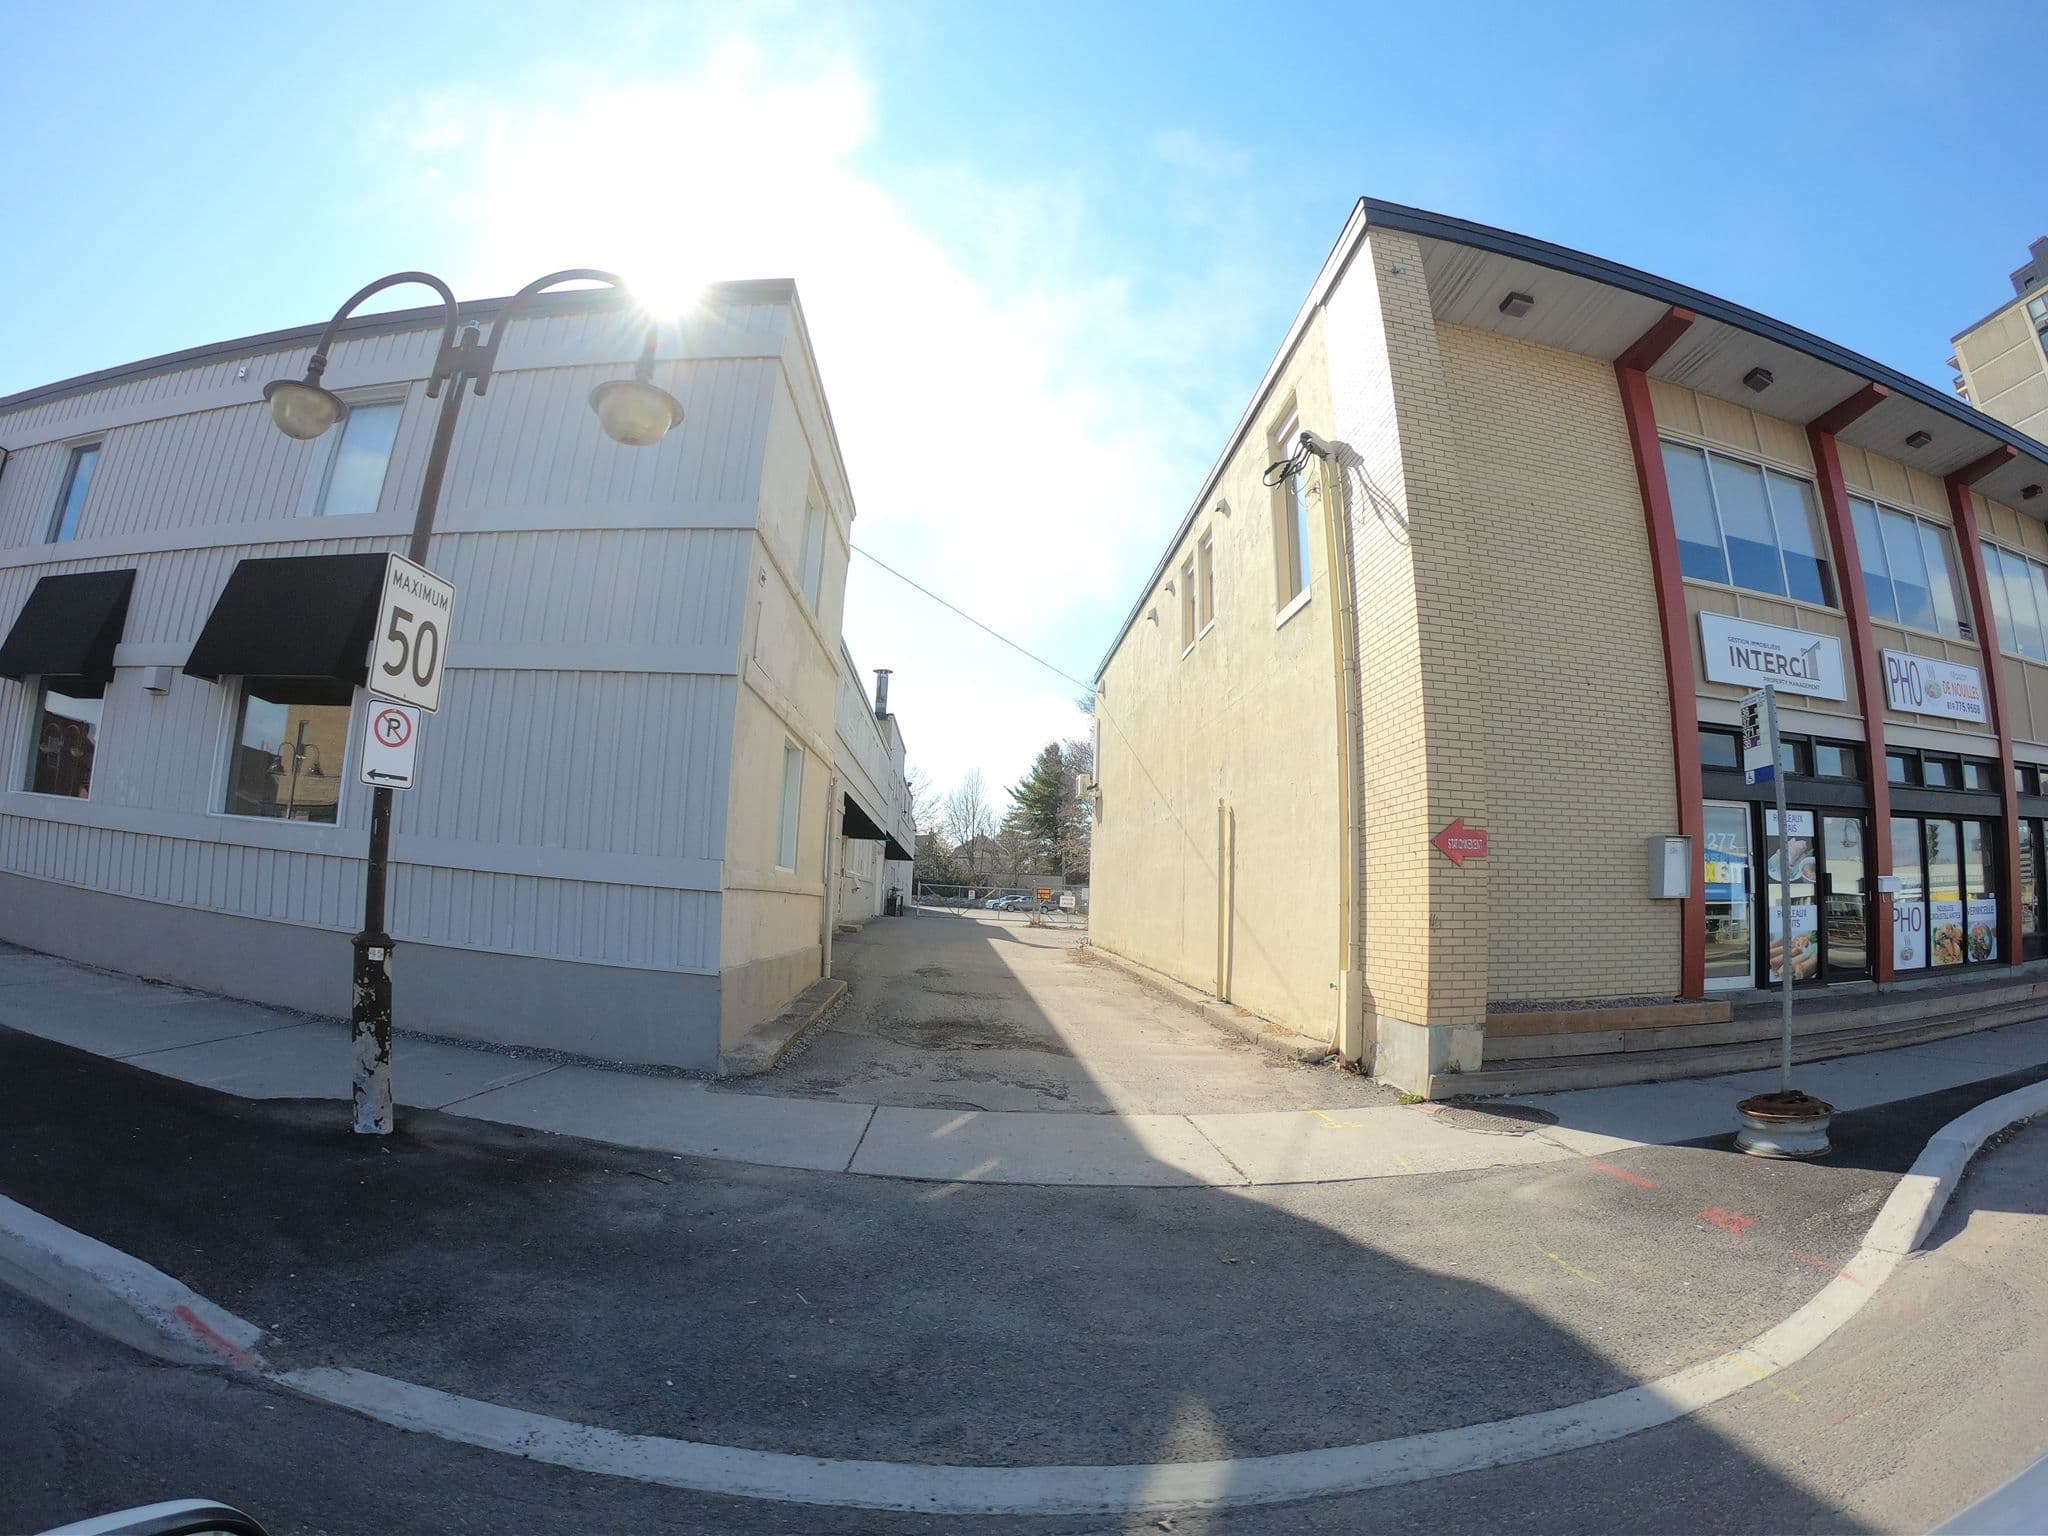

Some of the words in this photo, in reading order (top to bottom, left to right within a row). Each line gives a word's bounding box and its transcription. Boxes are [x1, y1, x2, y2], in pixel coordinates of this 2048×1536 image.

[393, 569, 449, 612] MAXIMUM
[383, 605, 439, 688] 50
[1887, 656, 1923, 707] PHO
[386, 718, 401, 738] P
[1707, 832, 1737, 849] 277
[1893, 906, 1922, 932] PHO
